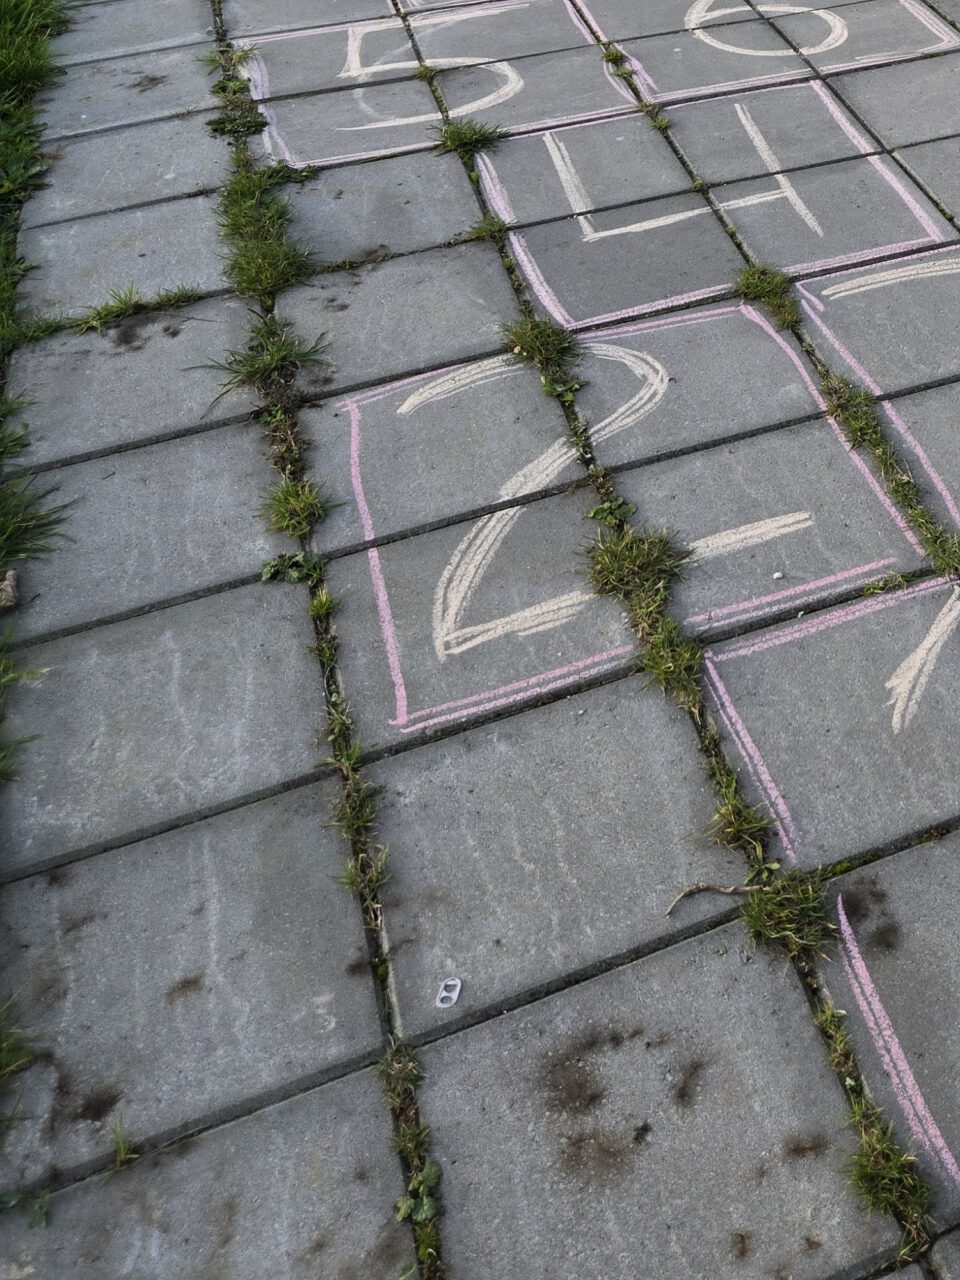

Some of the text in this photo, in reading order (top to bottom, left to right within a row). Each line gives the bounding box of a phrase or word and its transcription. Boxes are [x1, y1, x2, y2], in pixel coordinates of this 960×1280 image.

[333, 3, 530, 131] 5
[542, 103, 824, 242] 4
[397, 340, 813, 661] 2
